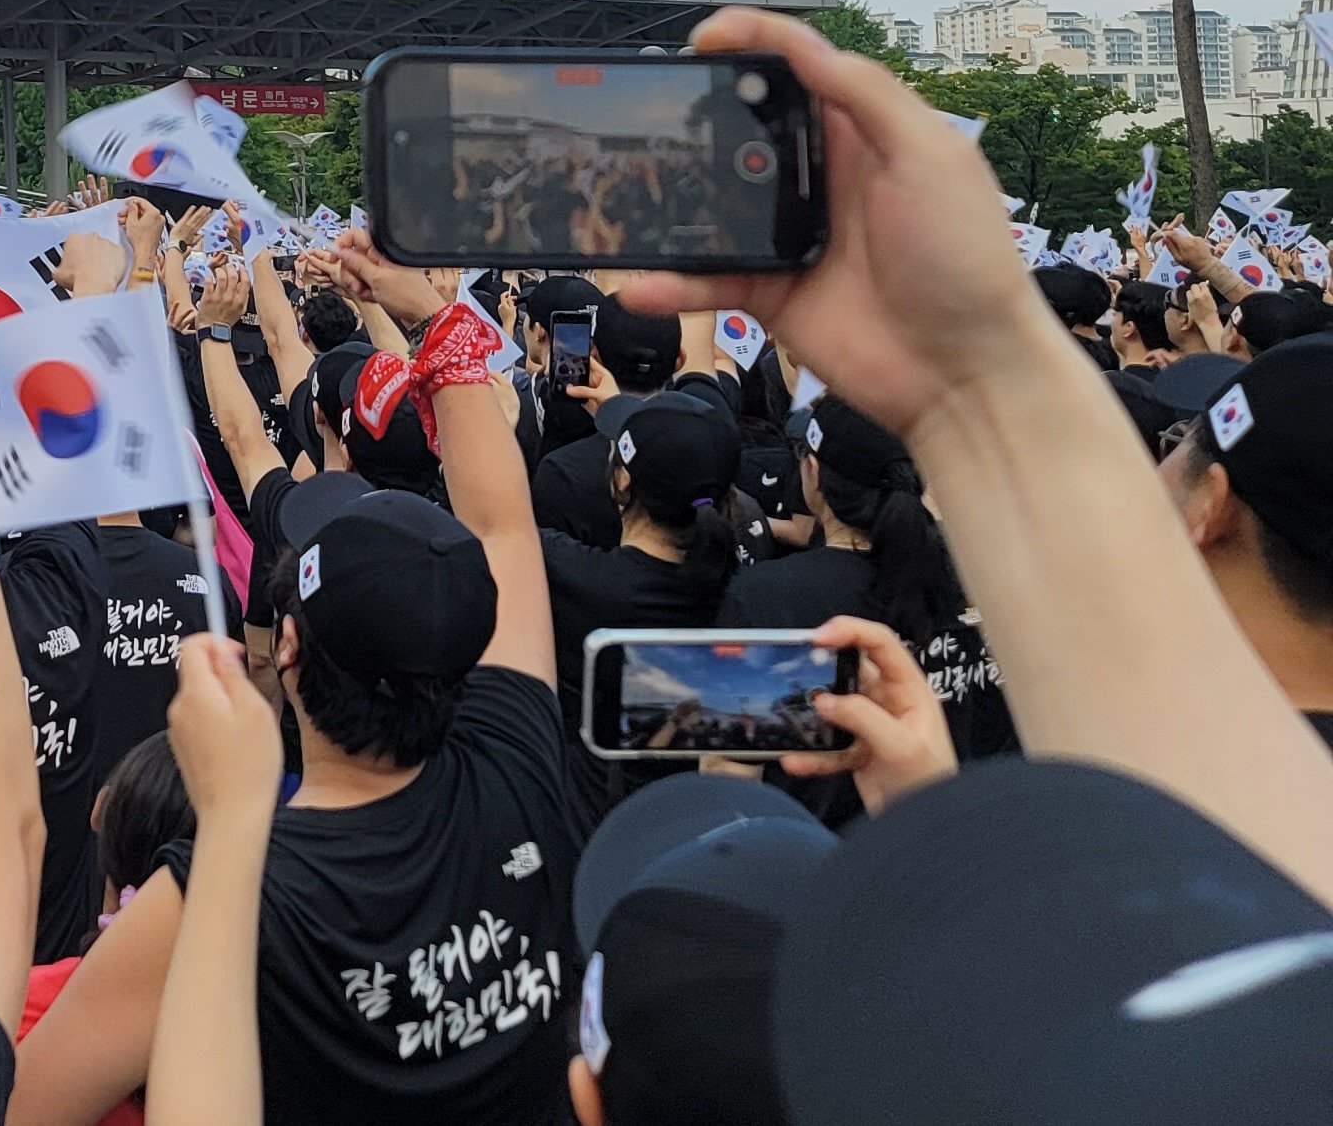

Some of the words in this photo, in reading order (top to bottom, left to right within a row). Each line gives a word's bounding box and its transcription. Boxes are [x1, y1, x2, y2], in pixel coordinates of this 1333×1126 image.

[340, 961, 398, 1023] 잘
[407, 909, 531, 1014] 될거야,
[395, 950, 562, 1061] 대한민국!
